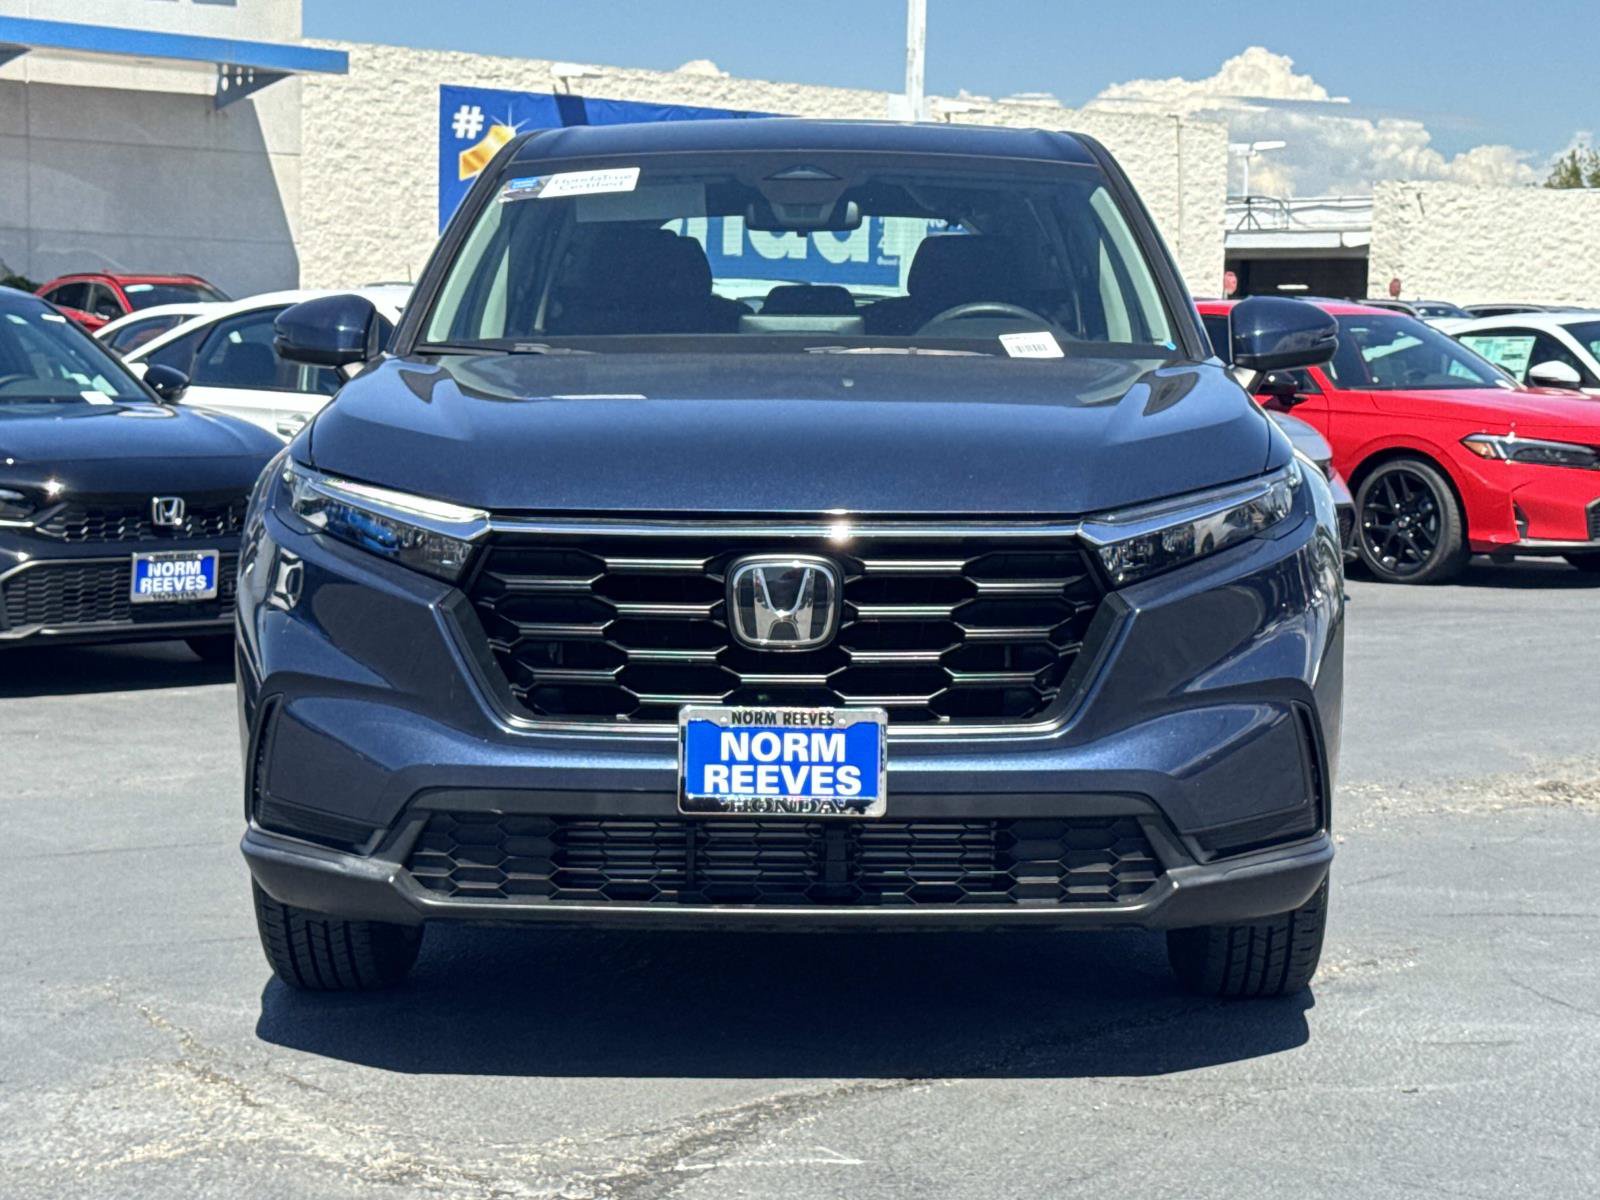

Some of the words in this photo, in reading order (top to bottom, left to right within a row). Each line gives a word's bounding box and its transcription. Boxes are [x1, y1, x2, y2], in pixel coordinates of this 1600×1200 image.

[147, 560, 202, 577] NORM
[140, 575, 207, 594] REEVES
[731, 711, 777, 726] NORM
[782, 711, 835, 726] REEVES
[720, 731, 846, 763] NORM
[703, 764, 862, 796] REEVES
